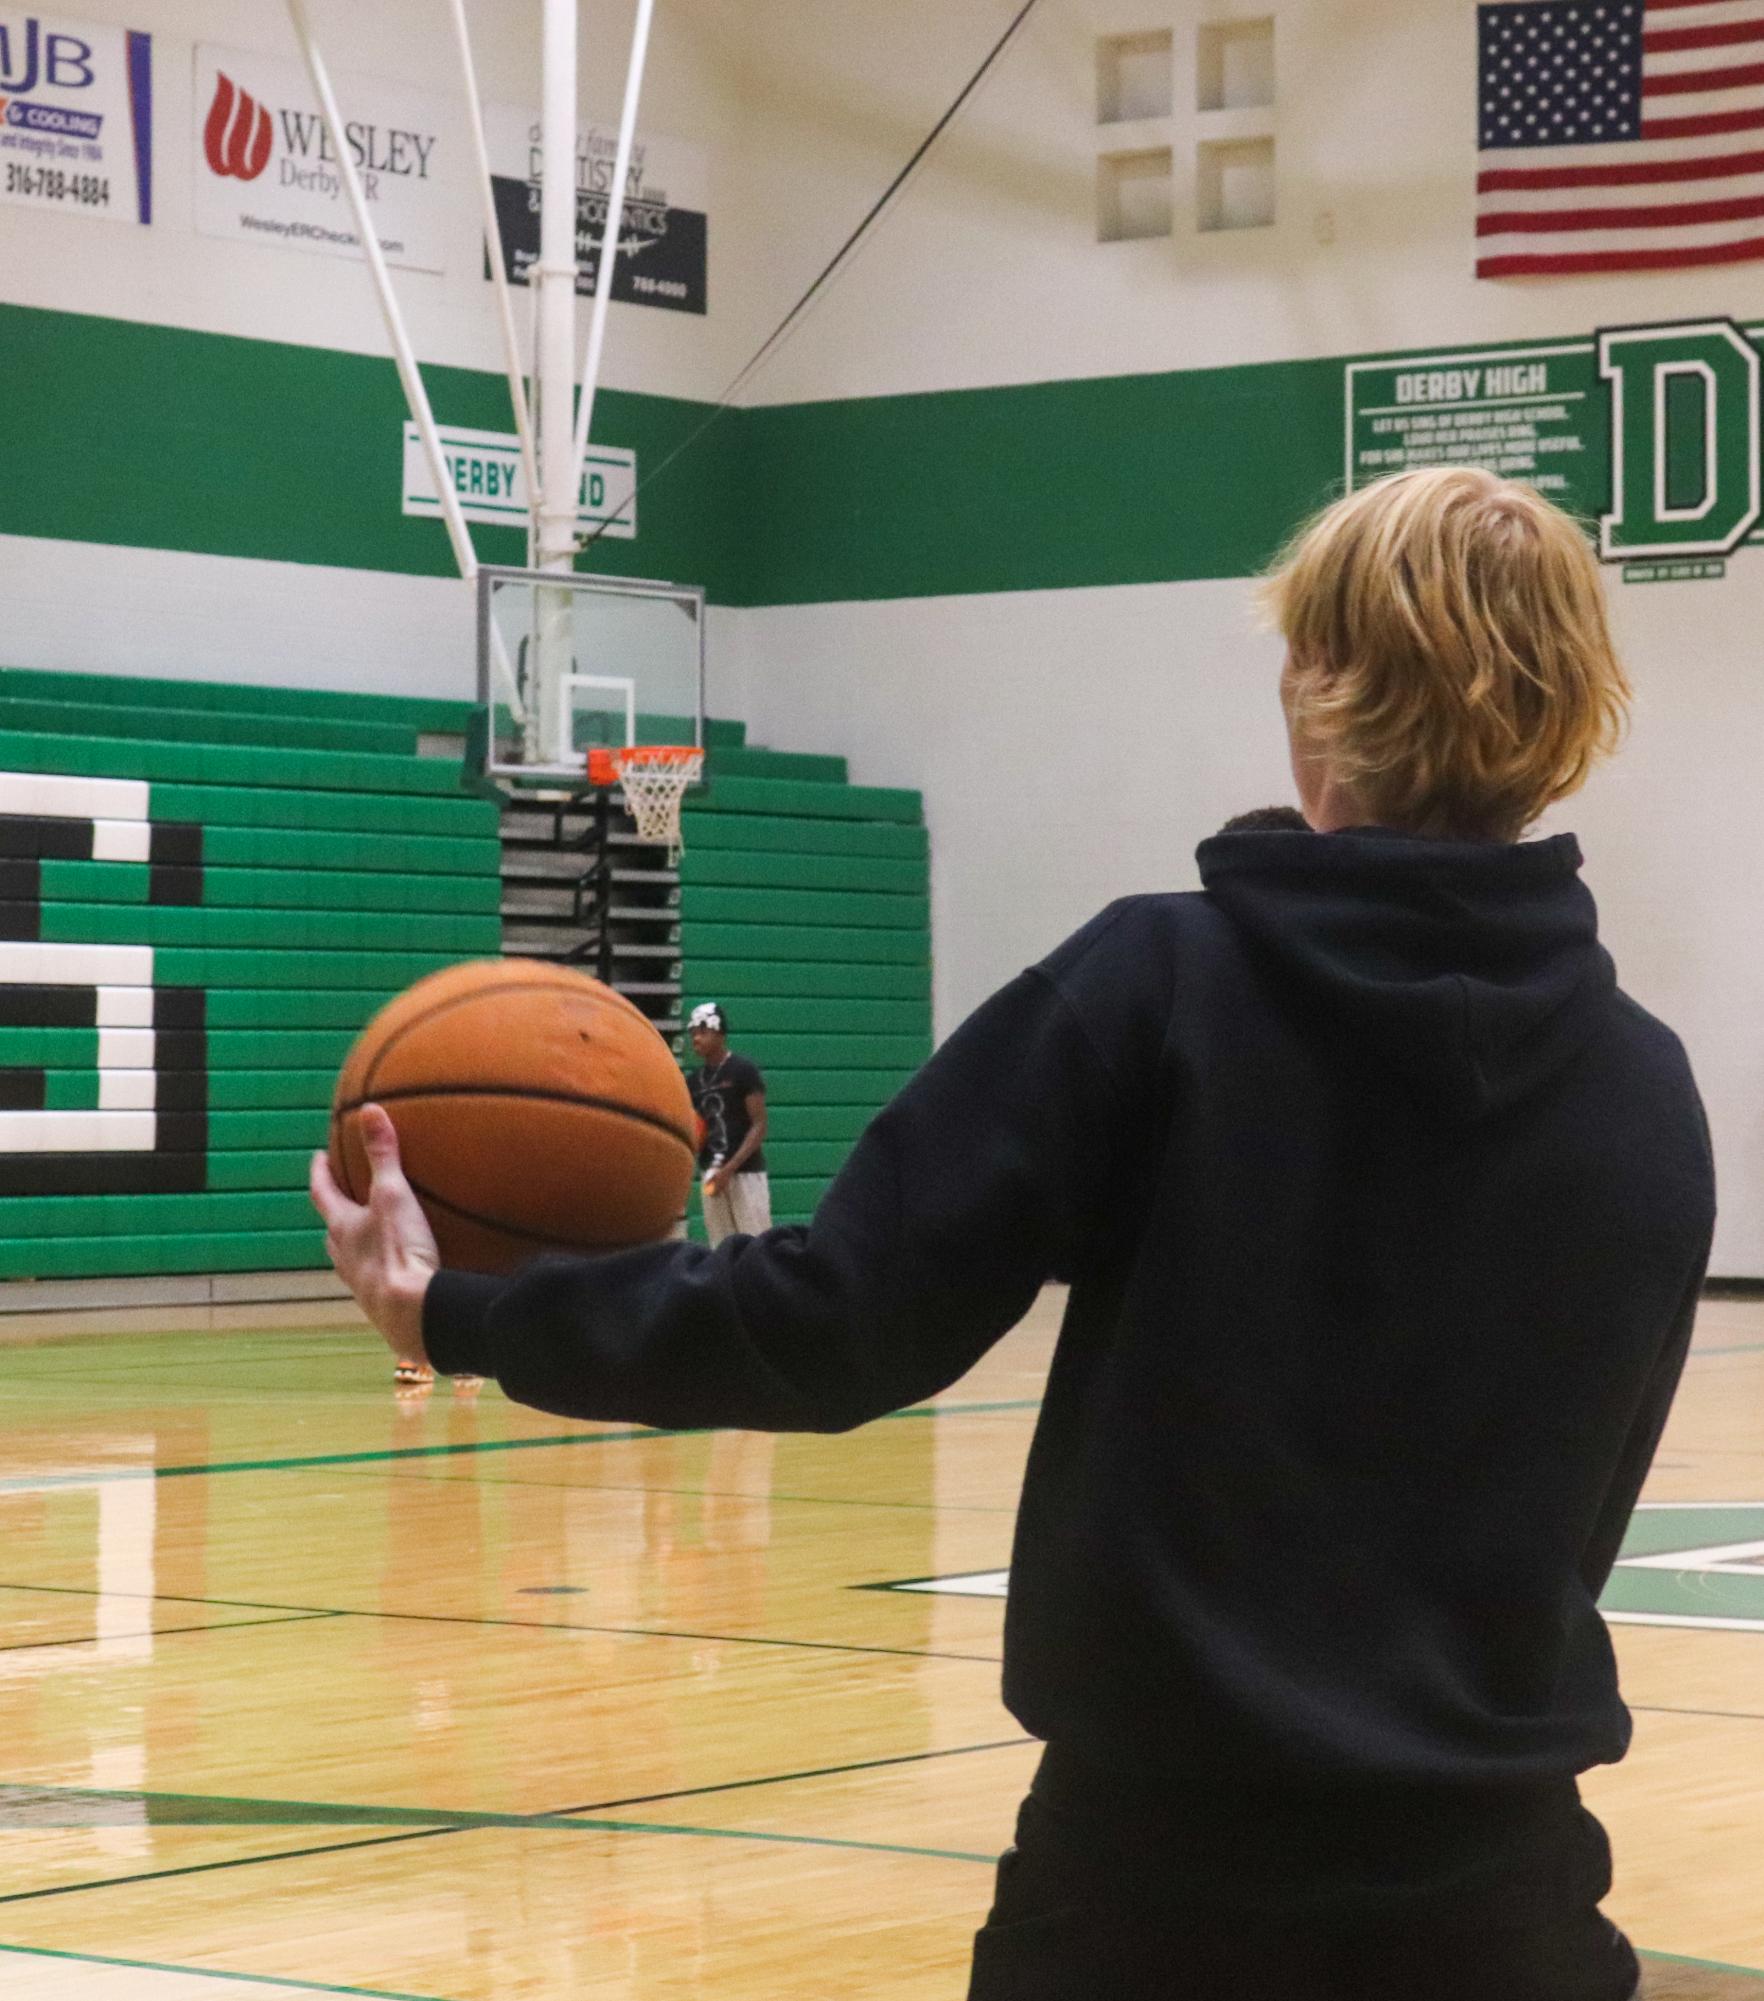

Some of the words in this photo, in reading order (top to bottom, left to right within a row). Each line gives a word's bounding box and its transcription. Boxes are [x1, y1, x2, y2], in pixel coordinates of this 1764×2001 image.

[27, 108, 98, 137] COOLING
[6, 160, 109, 207] 316-788-4884
[280, 157, 340, 200] Derby
[1396, 369, 1482, 405] DERBY
[1485, 363, 1547, 397] HIGH
[1599, 320, 1762, 560] D
